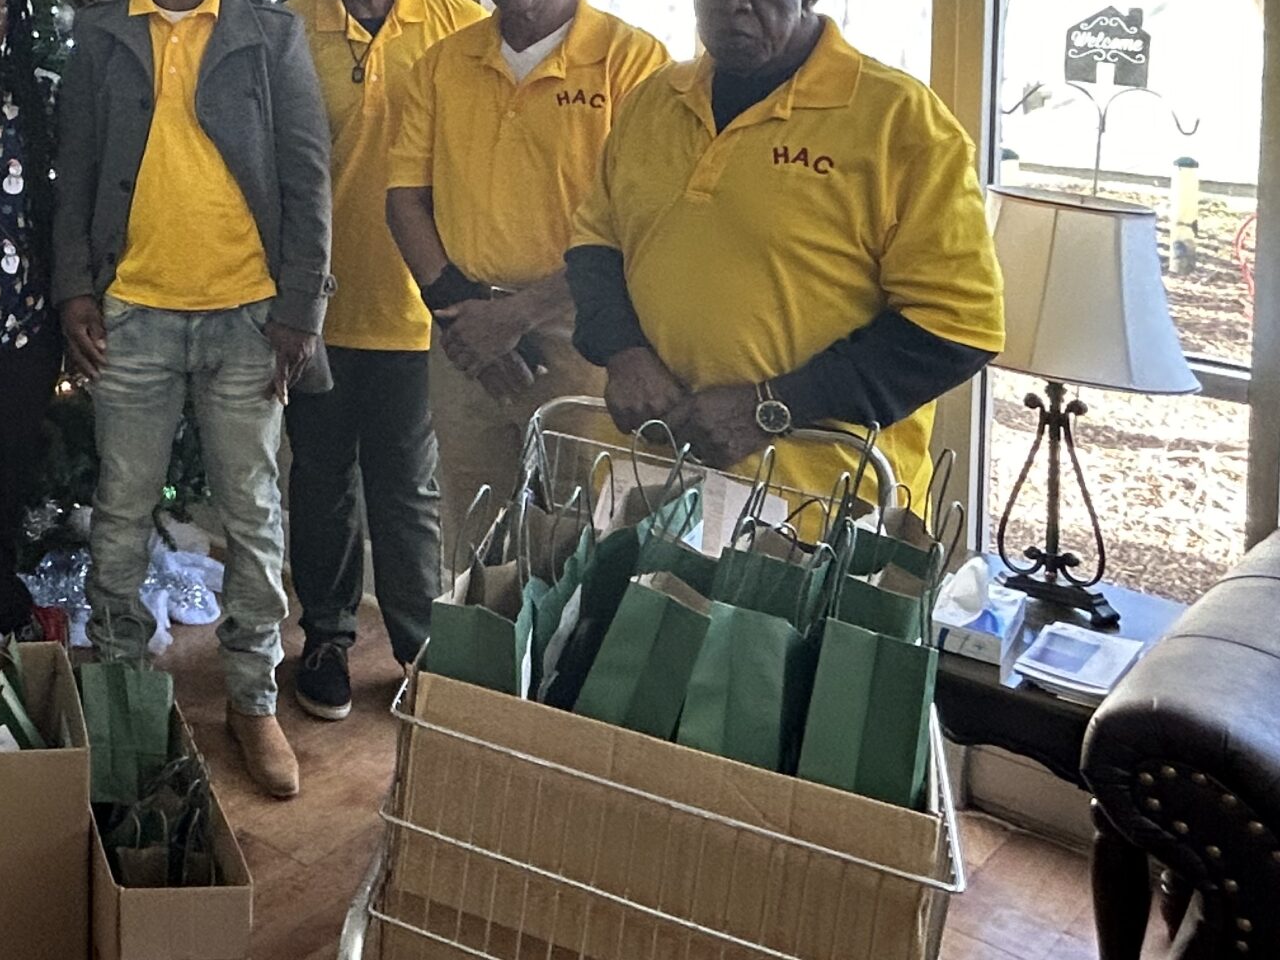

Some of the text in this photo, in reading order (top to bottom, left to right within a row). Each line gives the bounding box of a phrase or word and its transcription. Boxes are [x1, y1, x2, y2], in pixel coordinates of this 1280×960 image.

[1070, 30, 1144, 52] Welcome
[556, 89, 606, 109] HAC
[772, 145, 835, 175] HAC
